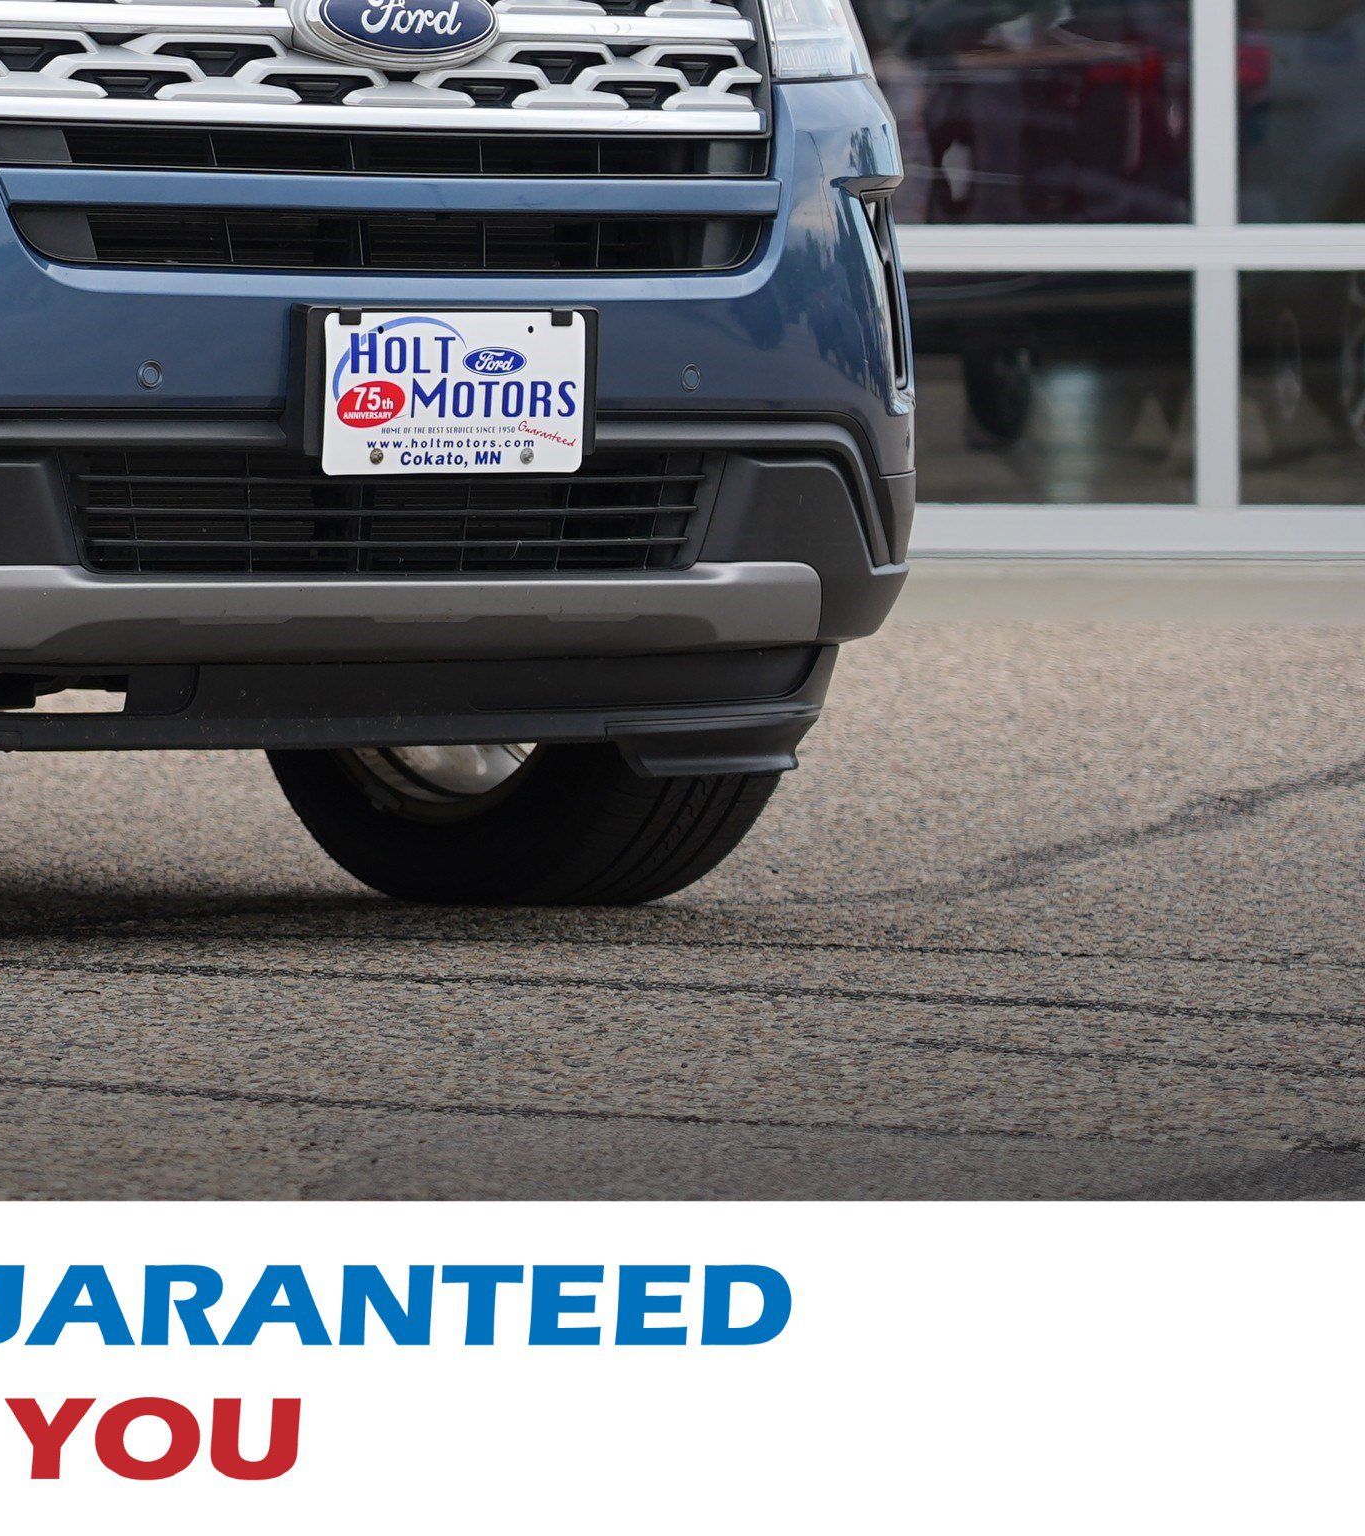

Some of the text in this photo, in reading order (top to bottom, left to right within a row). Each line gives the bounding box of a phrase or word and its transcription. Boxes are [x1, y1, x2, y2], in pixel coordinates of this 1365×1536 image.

[350, 332, 456, 374] HOLT
[475, 351, 515, 371] Ford
[352, 386, 394, 411] 75th
[410, 377, 577, 419] MOTORS
[343, 411, 393, 420] ANNIVERSARY
[446, 426, 473, 434] SERVICE
[518, 420, 577, 447] Guaranteed
[367, 438, 534, 449] www.holtmotors.com
[400, 451, 501, 469] Cokato, MN
